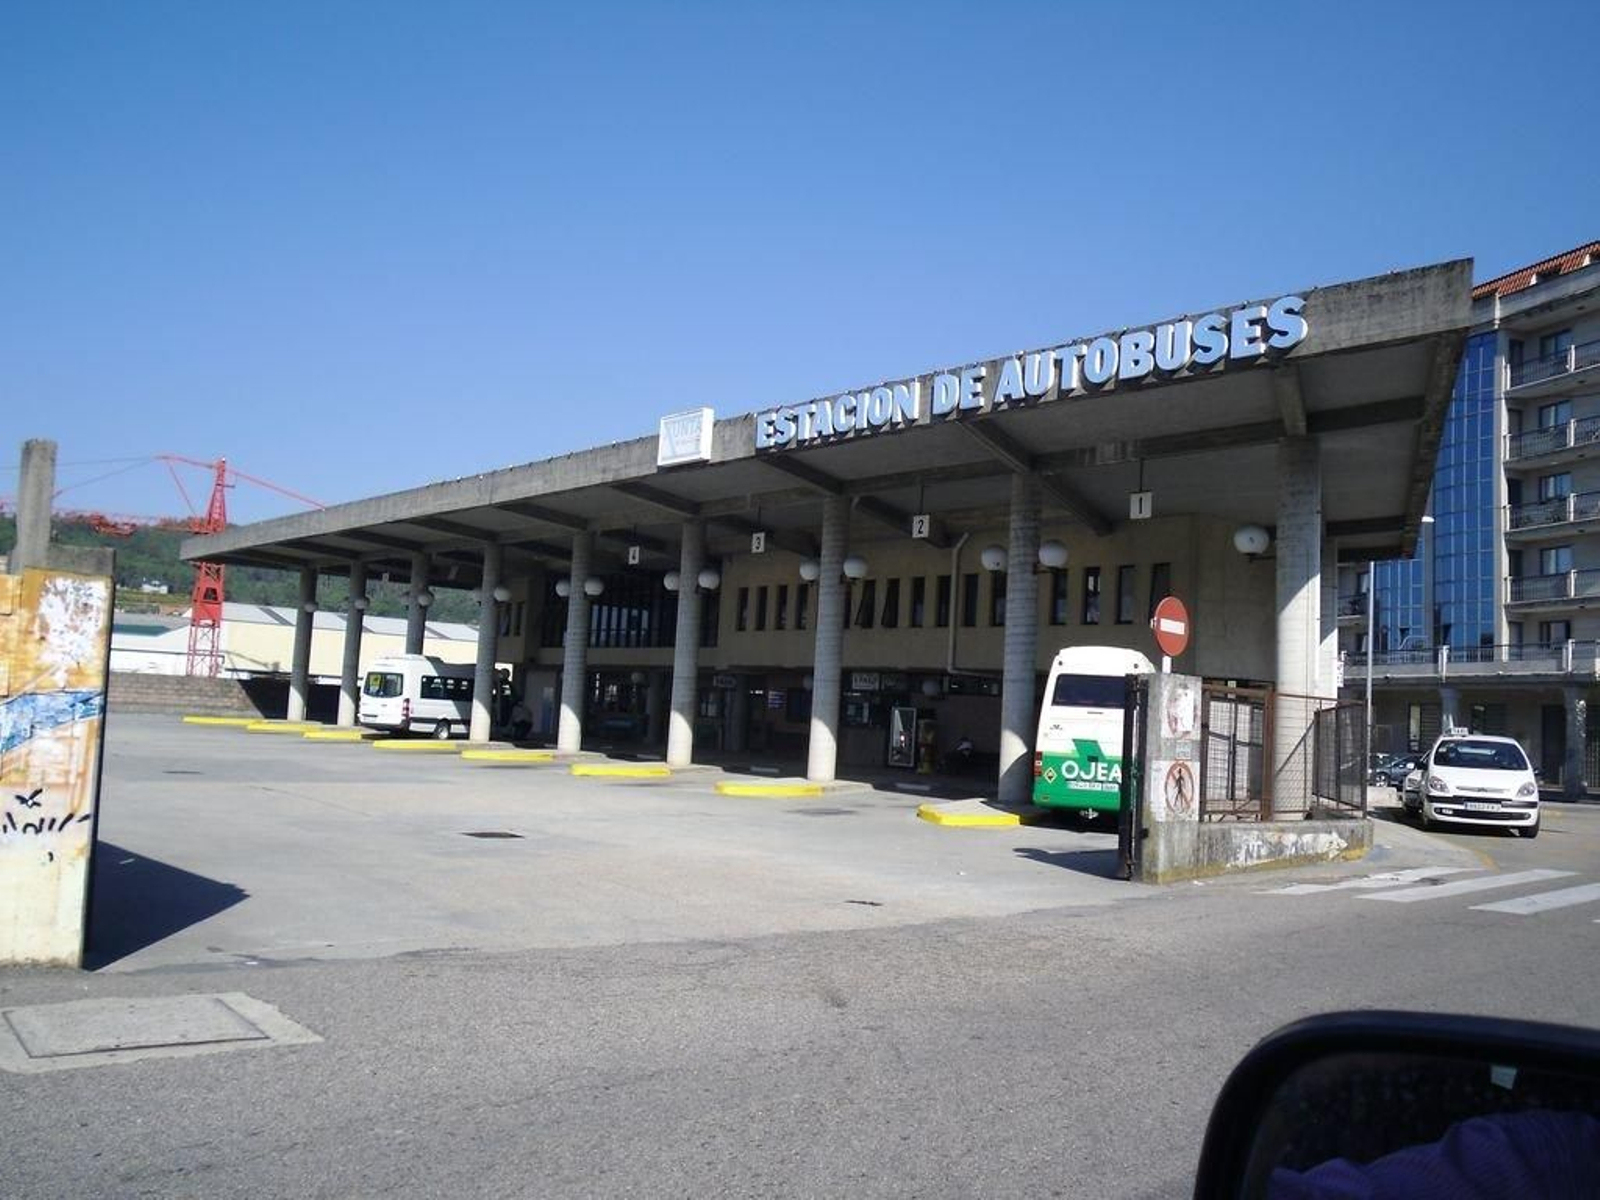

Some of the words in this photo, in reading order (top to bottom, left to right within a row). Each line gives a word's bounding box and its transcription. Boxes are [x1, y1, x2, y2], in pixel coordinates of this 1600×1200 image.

[755, 381, 920, 449] ESTACION
[932, 367, 986, 415] DE
[994, 296, 1309, 403] AUTOBUSES
[1061, 760, 1122, 783] OJEA
